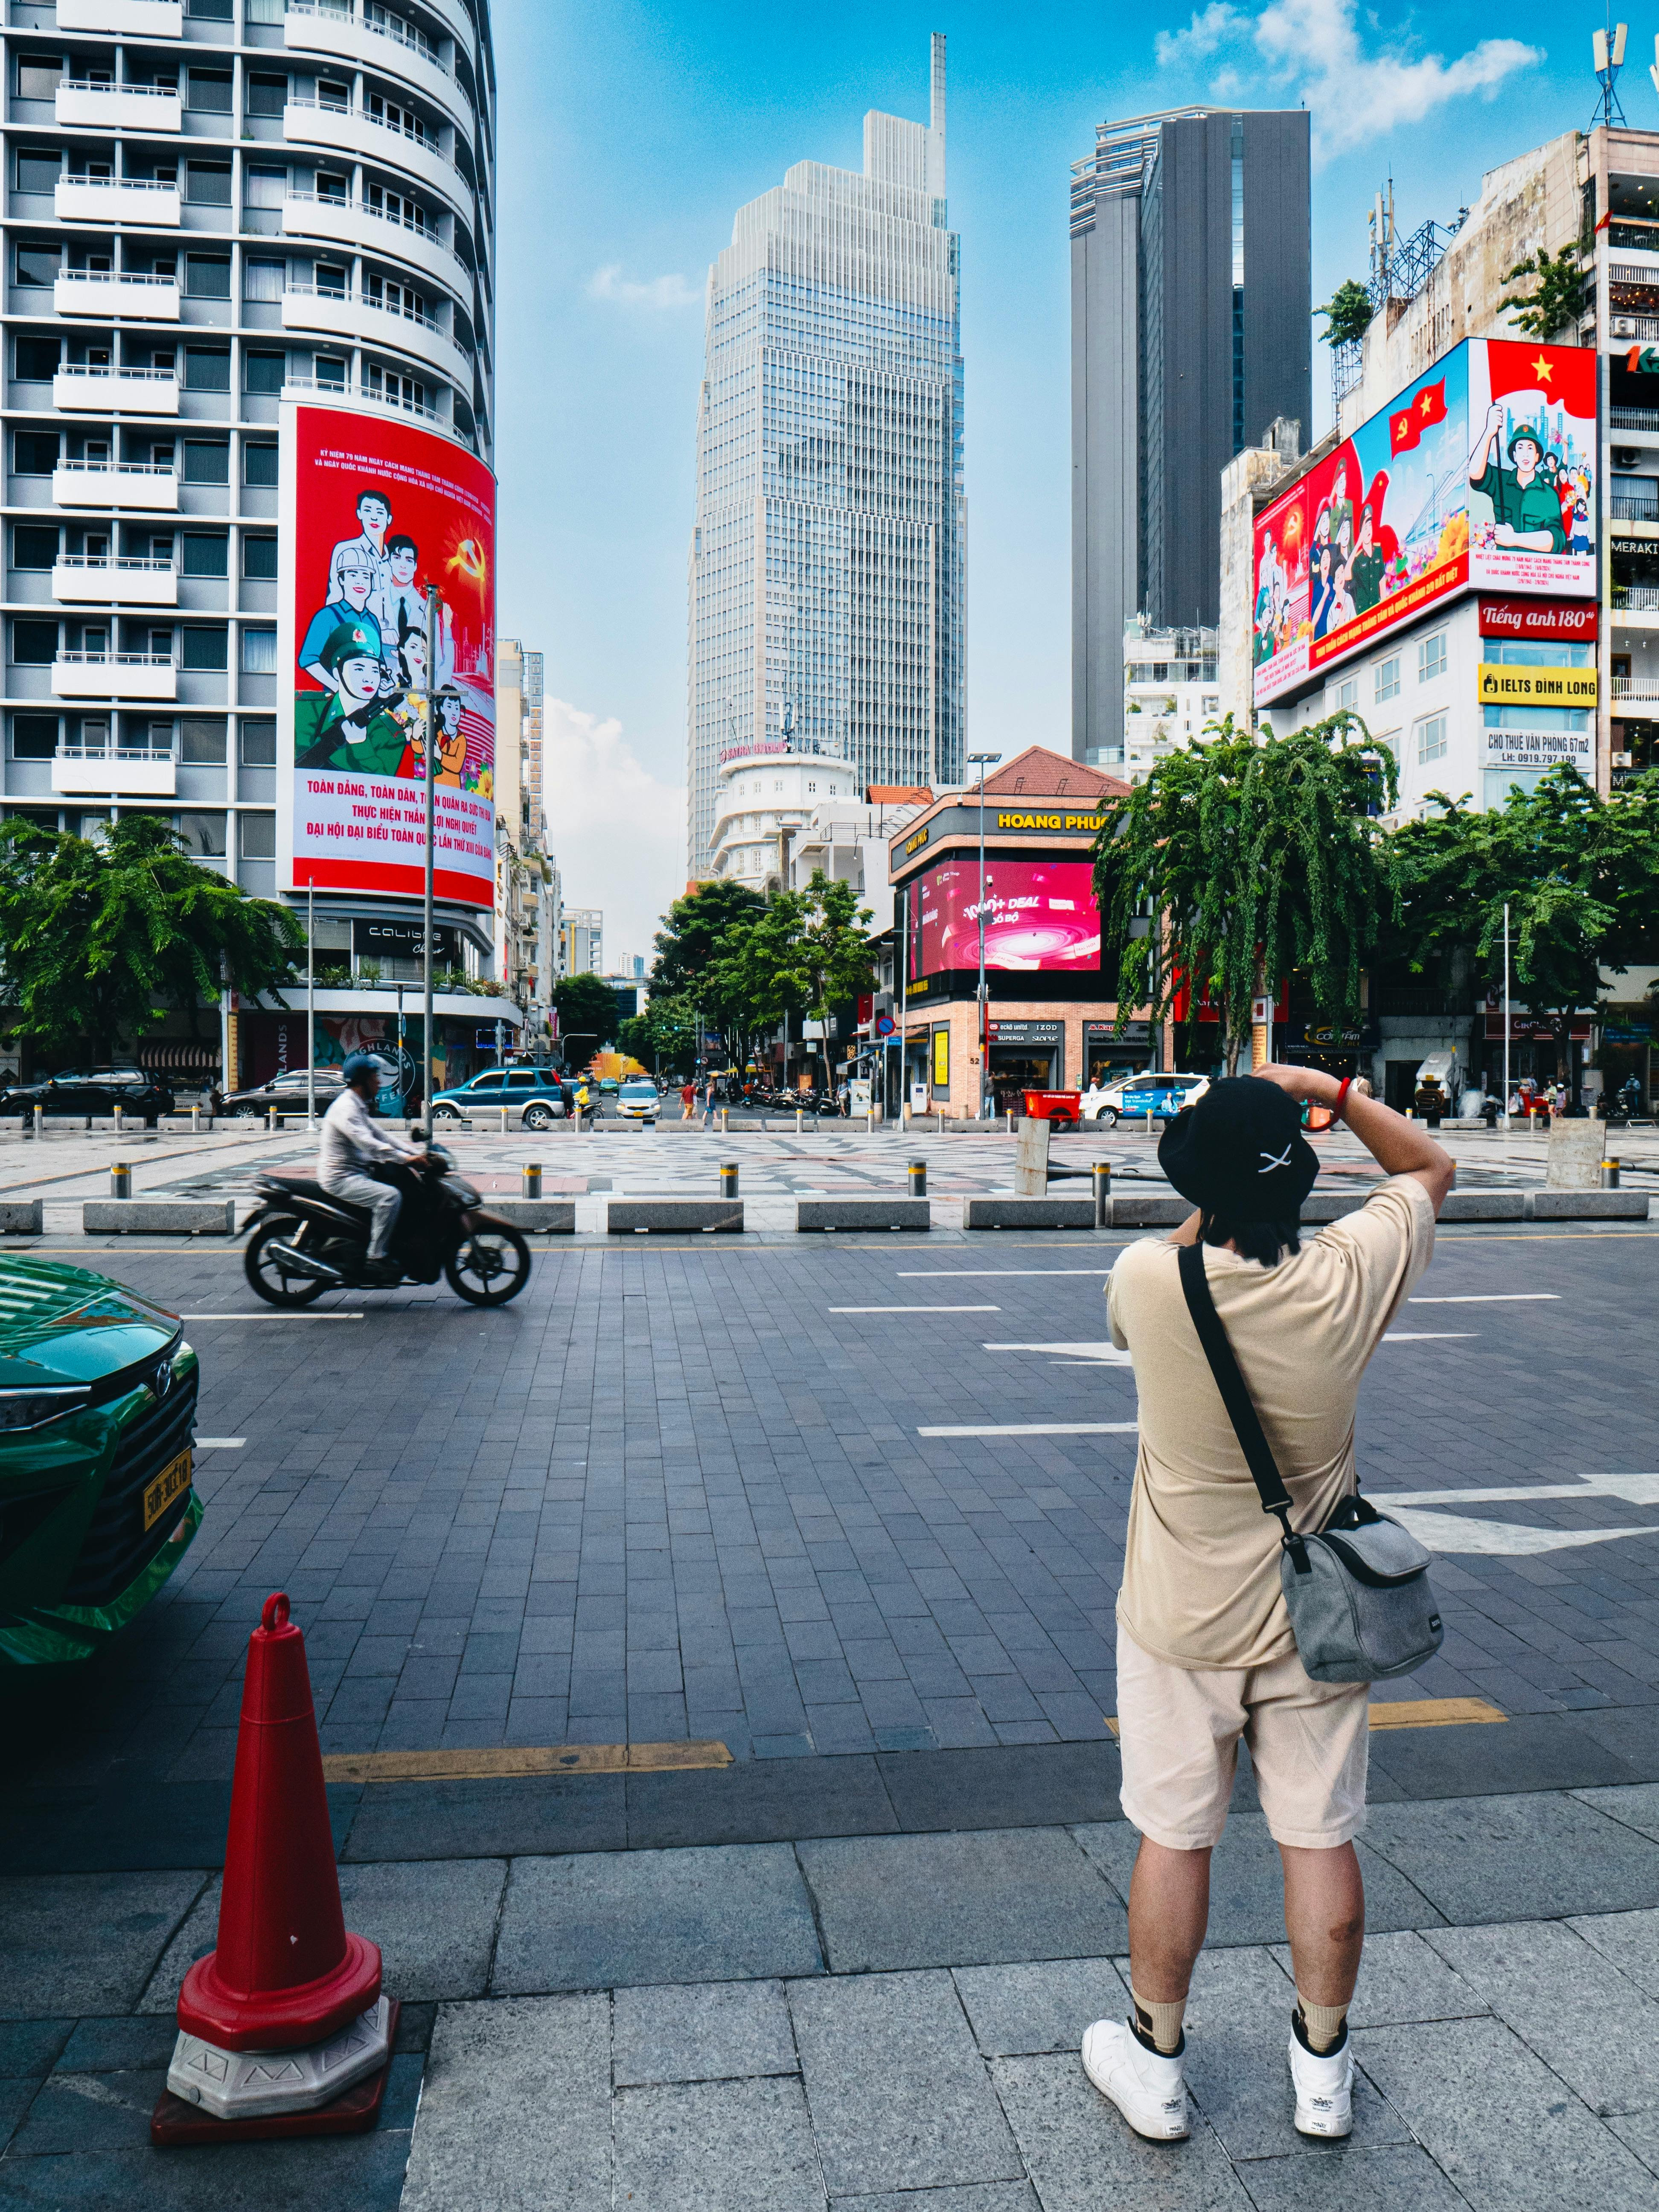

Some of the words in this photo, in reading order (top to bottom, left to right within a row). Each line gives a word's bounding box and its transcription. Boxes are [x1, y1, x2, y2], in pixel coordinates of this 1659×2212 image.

[1483, 605, 1522, 629] Tiếng
[1558, 611, 1586, 628] 180
[1501, 679, 1531, 693] IELTS
[1535, 678, 1563, 694] ĐÌNH
[1567, 681, 1595, 695] LONG
[728, 745, 751, 760] SATRA
[753, 742, 787, 754] GROUP
[1488, 733, 1503, 750] CHO
[1505, 732, 1523, 751] THUÊ
[1526, 733, 1540, 751] VĂN
[1543, 733, 1567, 752] PHÒNG
[1569, 738, 1589, 753] 67m2
[1502, 753, 1515, 762] LH:
[307, 779, 334, 794] TOÀN
[337, 780, 368, 799] ĐẢNG,
[371, 784, 395, 800] TOÀN
[398, 787, 418, 804] DÂN,
[420, 792, 439, 806] TN
[442, 796, 459, 811] QUÂN
[461, 800, 468, 813] RA
[469, 802, 478, 817] SỨC
[352, 805, 377, 820] THỰC
[380, 806, 401, 823] HIỆN
[404, 808, 426, 824] THẮN
[445, 817, 460, 833] NGHỊ
[462, 820, 477, 835] QUYẾT
[998, 814, 1061, 830] HOANG
[307, 822, 323, 838] ĐẠI
[327, 822, 344, 839] HỘI
[347, 825, 364, 841] ĐẠI
[367, 823, 388, 840] BIỂU
[391, 828, 413, 843] TOÀN
[416, 832, 437, 847] QUC
[439, 832, 452, 849] LẦN
[454, 838, 465, 852] THỨ
[466, 841, 474, 854] XIII
[1008, 896, 1039, 909] DEAL
[1004, 911, 1019, 923] BỘ
[278, 1024, 287, 1072] LANDS
